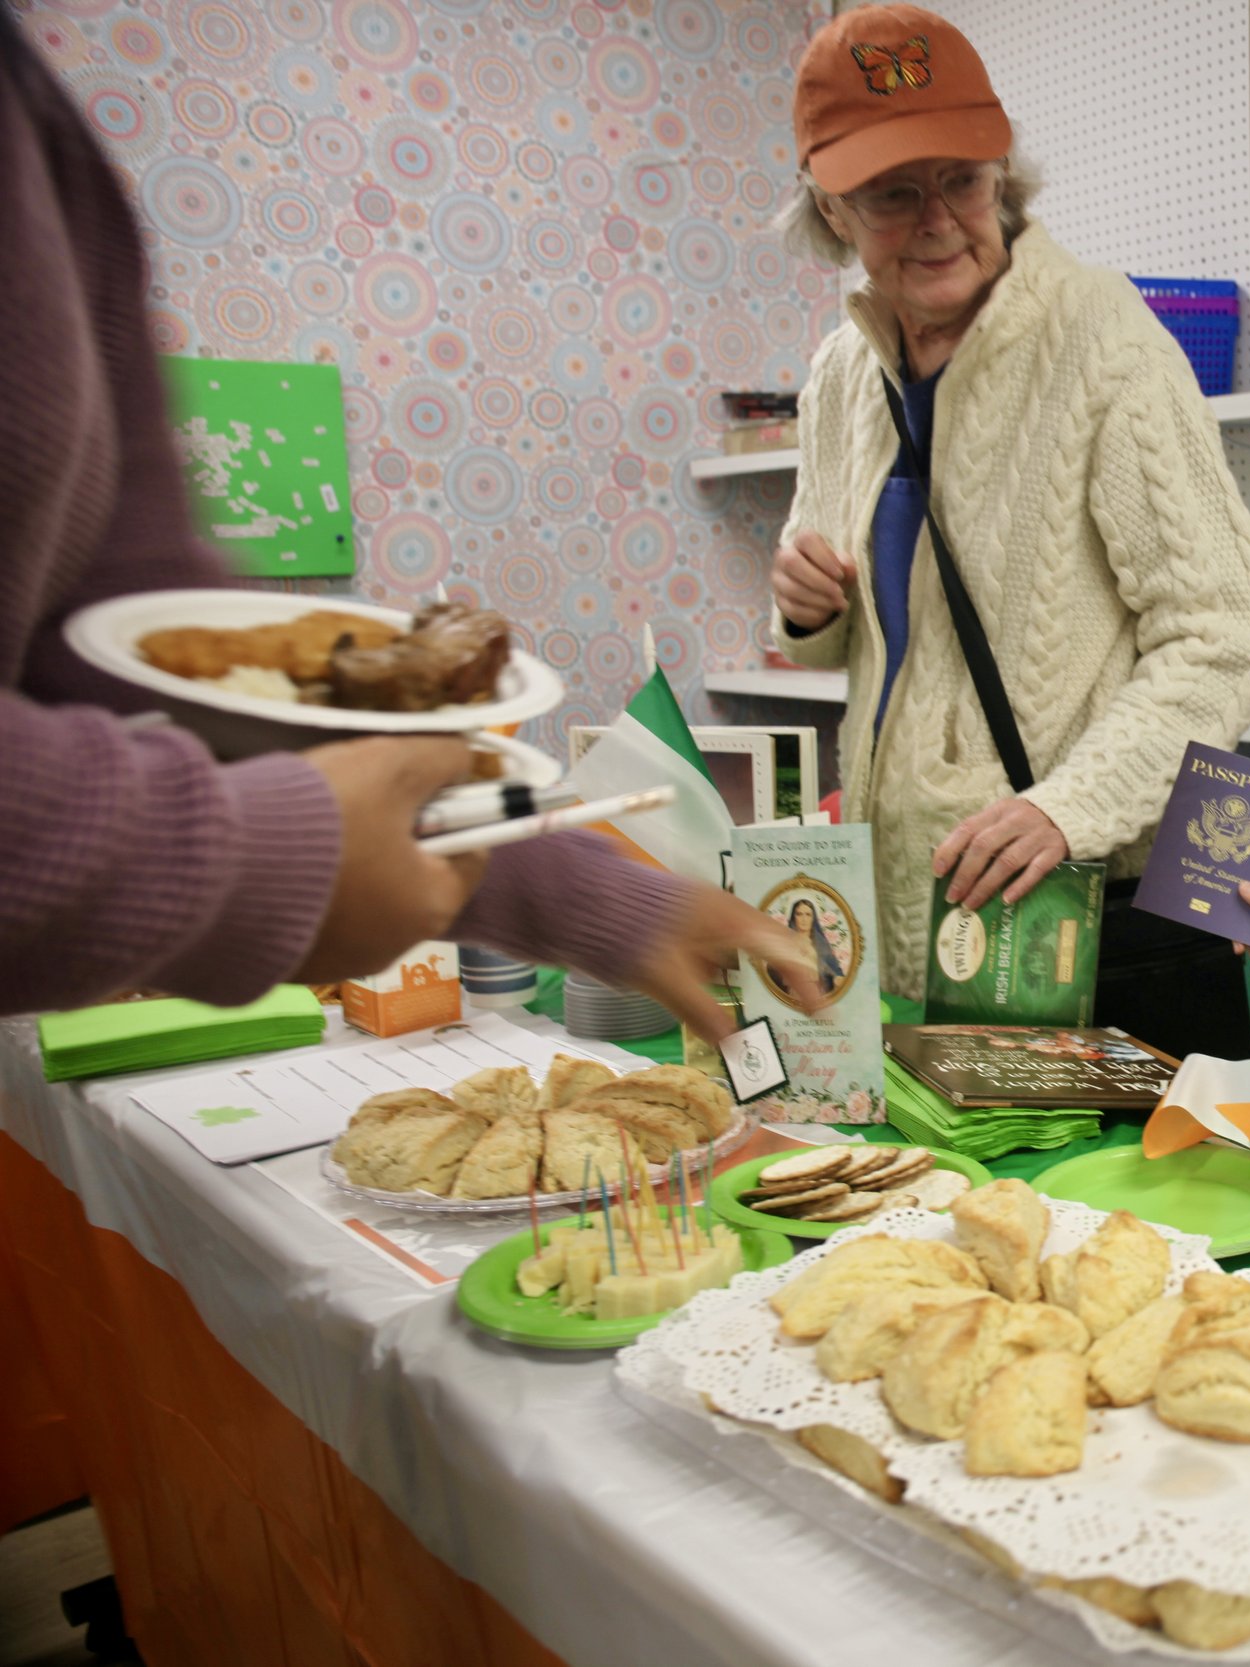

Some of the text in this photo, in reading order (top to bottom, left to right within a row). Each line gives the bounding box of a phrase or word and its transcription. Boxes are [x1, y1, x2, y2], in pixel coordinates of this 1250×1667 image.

[744, 840, 853, 852] YOUR GUIDE TO THE
[753, 856, 848, 867] GREEN SCAPULAR
[954, 912, 972, 975] TWININGS
[994, 904, 1013, 1004] IRISH BREAKFA
[1112, 1079, 1168, 1096] You
